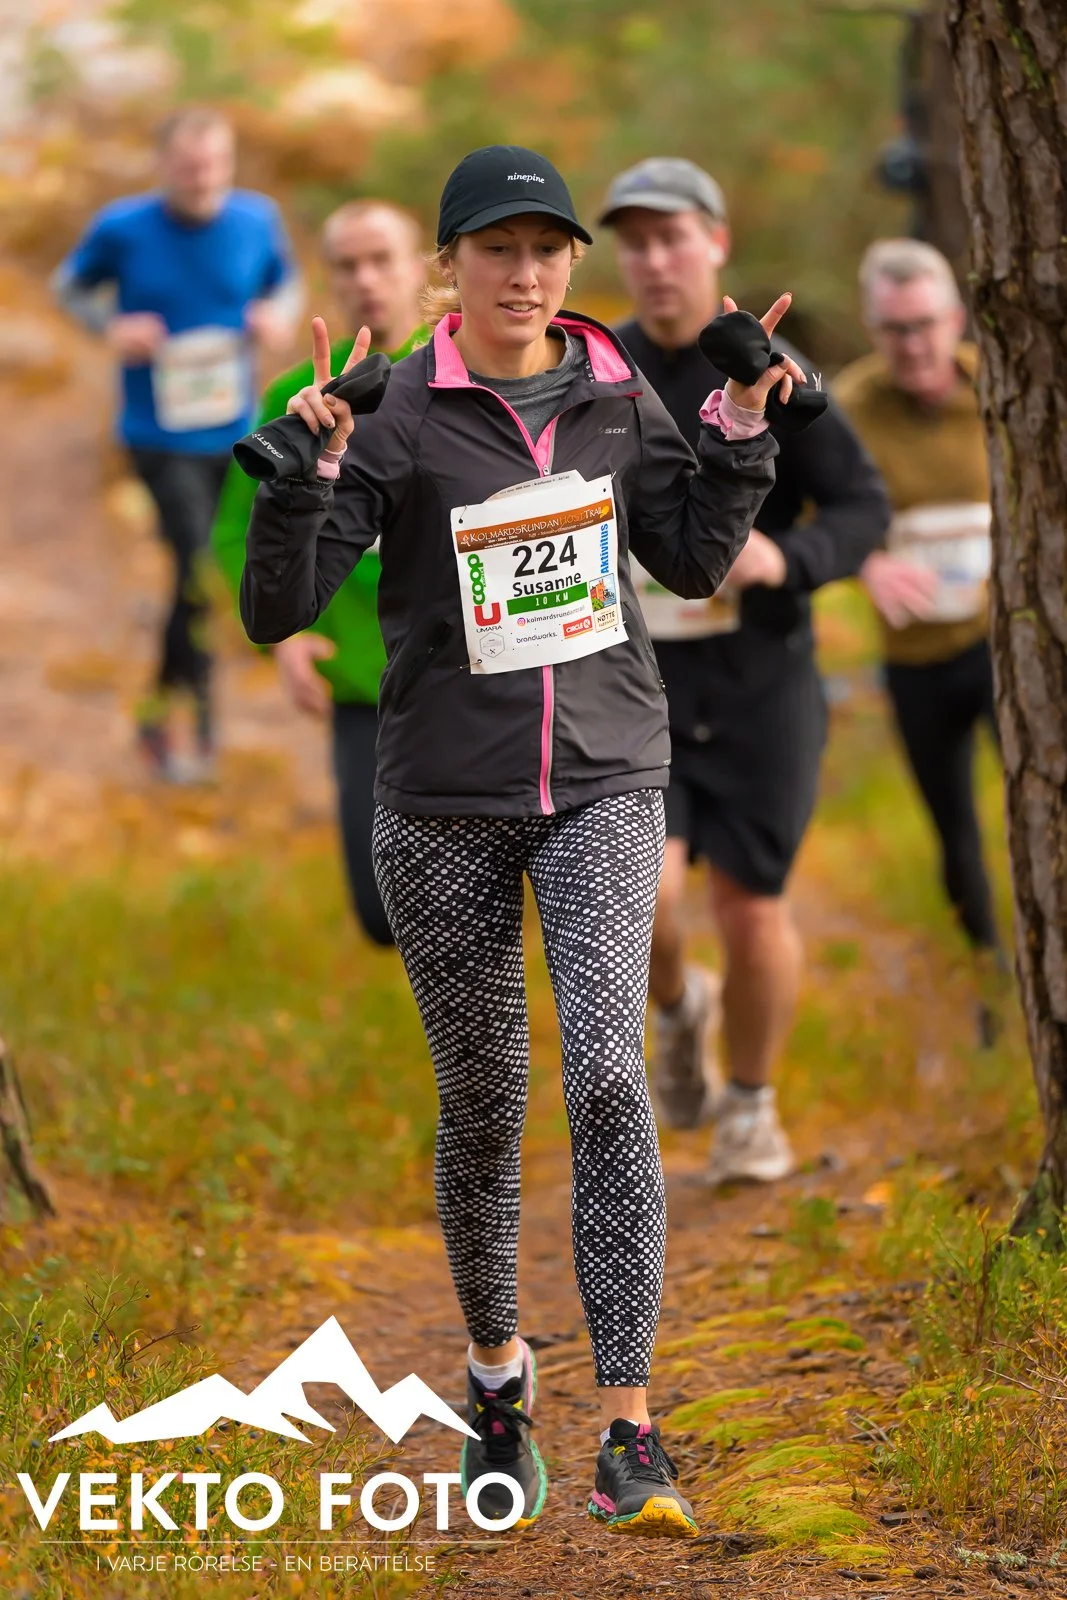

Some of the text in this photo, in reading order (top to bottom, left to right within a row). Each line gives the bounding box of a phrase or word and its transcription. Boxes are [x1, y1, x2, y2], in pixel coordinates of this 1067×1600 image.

[507, 172, 545, 184] ninepine
[256, 436, 284, 459] CRAFT
[512, 535, 578, 578] 224
[600, 523, 609, 574] Aktivitus
[467, 553, 485, 605] coop
[512, 572, 582, 598] Susanne
[535, 591, 569, 607] 10 KM
[476, 625, 503, 634] UMARA
[566, 622, 584, 633] CIRCLE
